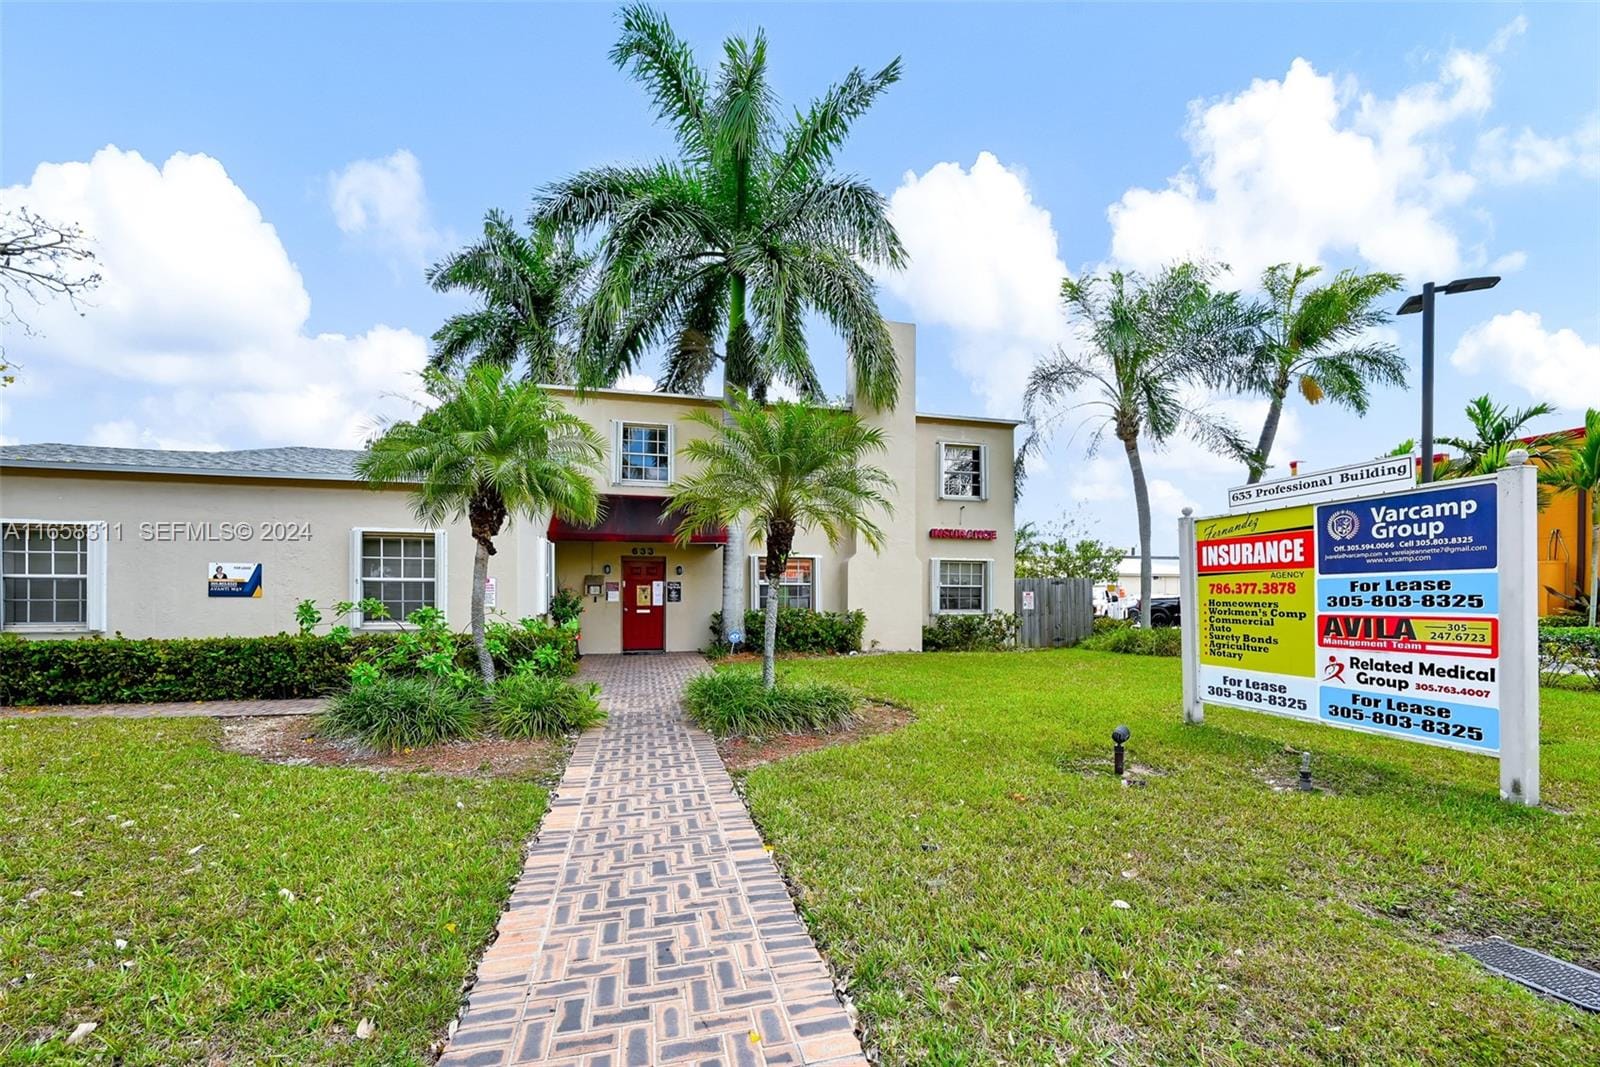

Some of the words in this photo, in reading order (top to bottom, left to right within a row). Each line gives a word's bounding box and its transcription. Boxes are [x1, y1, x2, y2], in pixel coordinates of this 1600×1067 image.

[1231, 491, 1253, 502] 633
[1256, 475, 1333, 498] Professional
[1339, 463, 1407, 484] Building
[1370, 499, 1478, 523] Varcamp
[1204, 514, 1259, 541] Fernandez
[1371, 520, 1445, 539] Group
[929, 528, 997, 541] INSURANCE
[1399, 540, 1414, 548] Cell
[1416, 536, 1474, 547] 305.803.8325
[631, 547, 655, 555] 633
[1201, 538, 1305, 567] INSURANCE
[1366, 554, 1432, 564] www.varcamp.com
[1270, 571, 1305, 579] AGENCY
[1209, 582, 1296, 595] 786.377.3878
[1350, 580, 1380, 592] For
[1385, 579, 1452, 592] Lease
[1208, 599, 1279, 608] Homeowners
[1326, 594, 1484, 608] 305-803-8325
[1208, 607, 1268, 617] Workmen's
[1270, 609, 1307, 620] Comp
[1208, 616, 1275, 626] Commercial
[1447, 623, 1467, 632] 305
[1208, 624, 1232, 633] Auto
[1323, 617, 1418, 641] AVILA
[1208, 632, 1241, 643] Surety
[1243, 634, 1279, 645] Bonds
[1323, 637, 1388, 649] Management
[1391, 640, 1422, 650] Team
[1430, 631, 1486, 643] 247.6723
[1208, 640, 1269, 653] Agriculture
[1208, 649, 1244, 661] Notary
[1349, 656, 1413, 675] Related
[1418, 662, 1496, 682] Medical
[1222, 675, 1243, 688] For
[1245, 678, 1287, 694] Lease
[1356, 671, 1409, 691] Group
[1415, 682, 1491, 699] 305.763.4007
[1207, 685, 1307, 711] 305-803-8325
[1351, 693, 1382, 708] For
[1386, 698, 1452, 719] Lease
[1328, 704, 1484, 742] 305-803-8325
